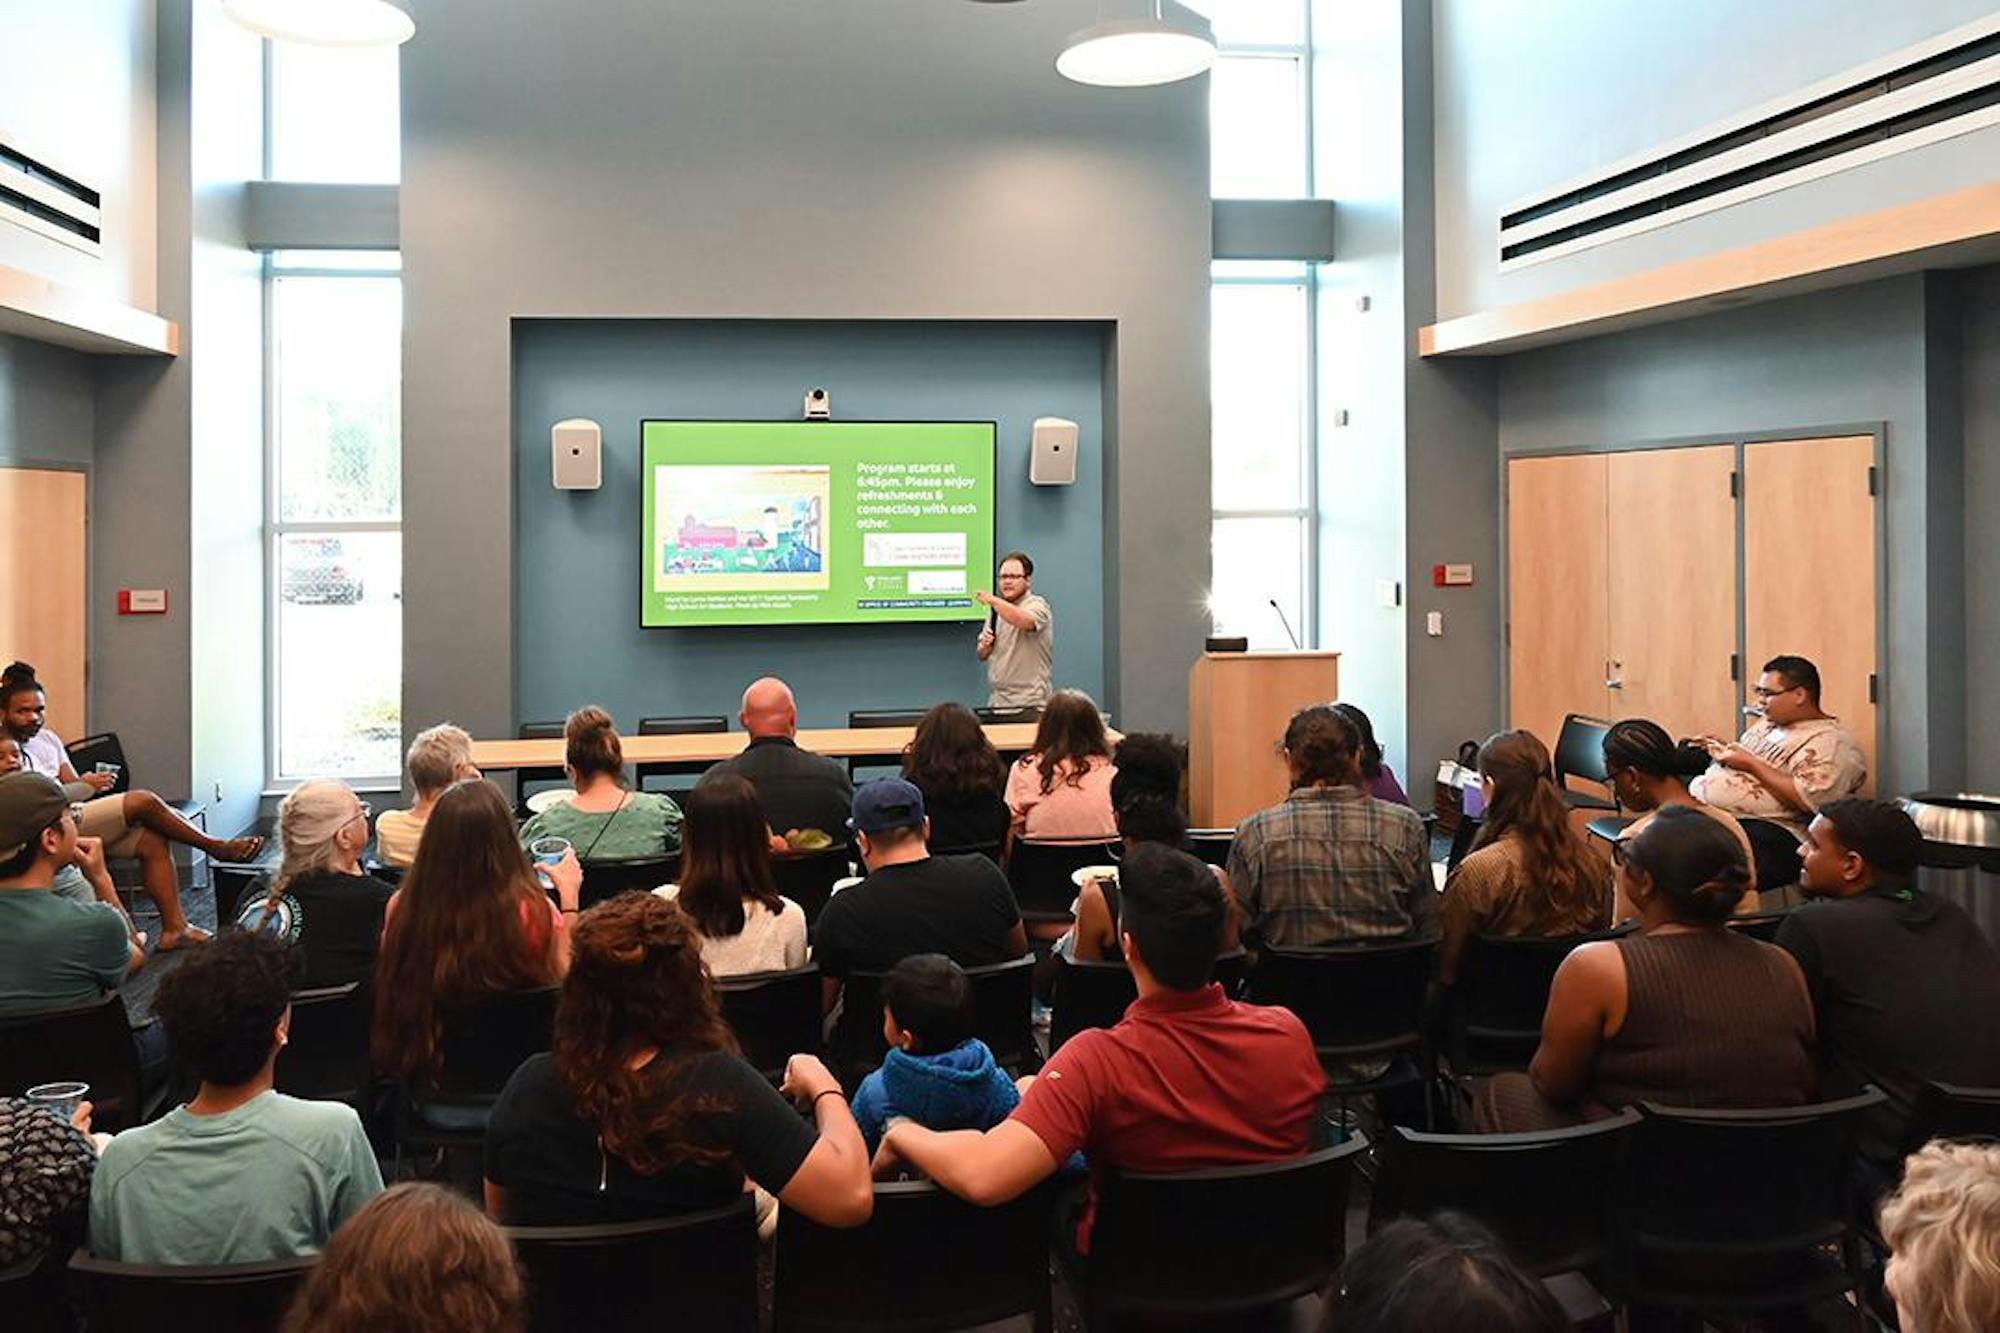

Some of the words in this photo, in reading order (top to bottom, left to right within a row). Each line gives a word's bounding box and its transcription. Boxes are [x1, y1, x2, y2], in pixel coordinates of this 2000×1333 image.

[857, 463, 906, 476] Program
[907, 463, 941, 473] starts
[943, 463, 955, 473] at
[904, 476, 942, 487] Please
[943, 476, 976, 489] enjoy
[857, 490, 933, 501] refreshments
[857, 504, 920, 517] connecting
[921, 504, 948, 514] with
[949, 504, 977, 514] each
[857, 518, 888, 529] other.
